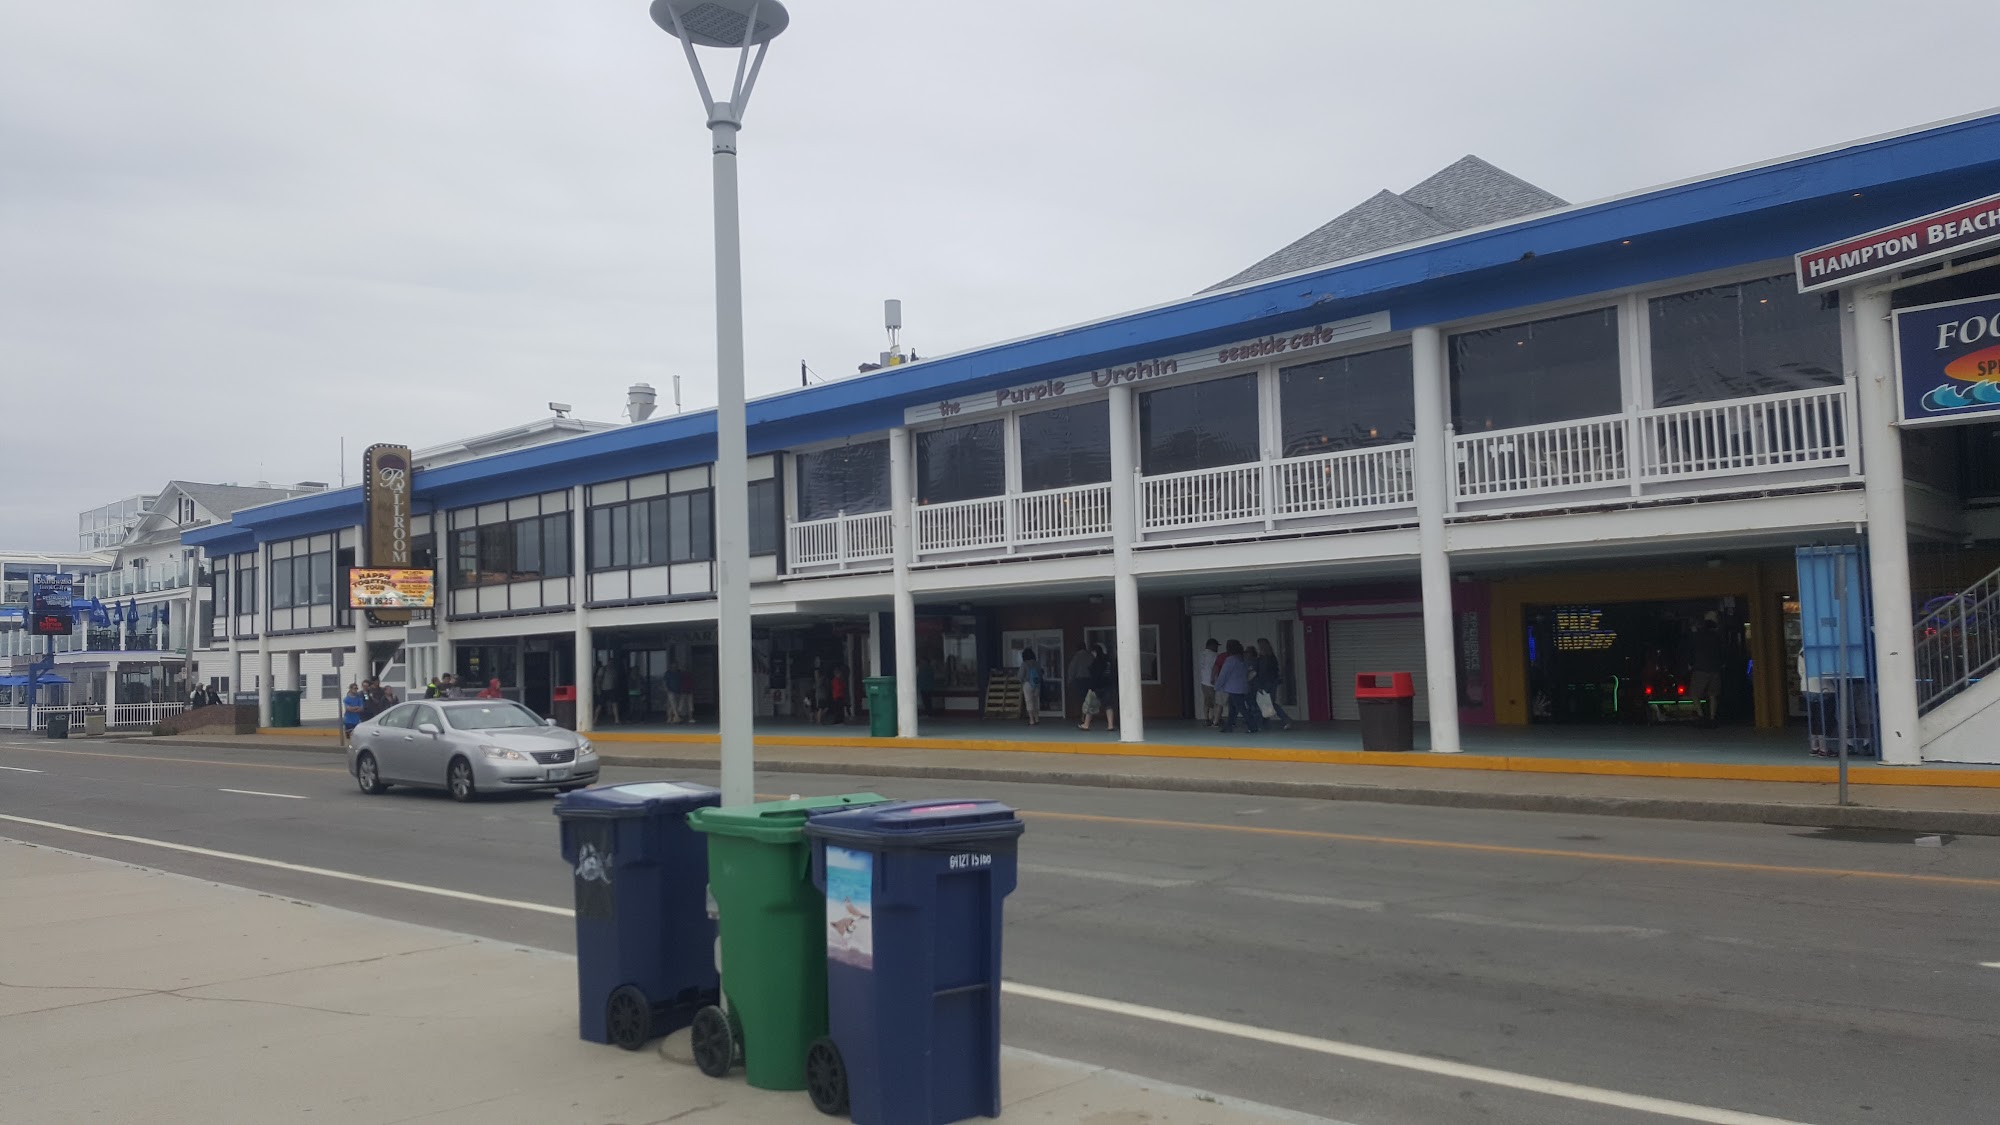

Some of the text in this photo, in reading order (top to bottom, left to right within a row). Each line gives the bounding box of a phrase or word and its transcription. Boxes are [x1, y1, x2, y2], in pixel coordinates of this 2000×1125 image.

[1808, 208, 2000, 278] HAMPTON BEACH
[940, 324, 1334, 416] the Purple Urchin seaside cafe
[1977, 359, 2000, 376] SP
[379, 467, 407, 563] BALLROOM
[351, 578, 397, 589] TOGETHER
[358, 572, 392, 580] HAPPY
